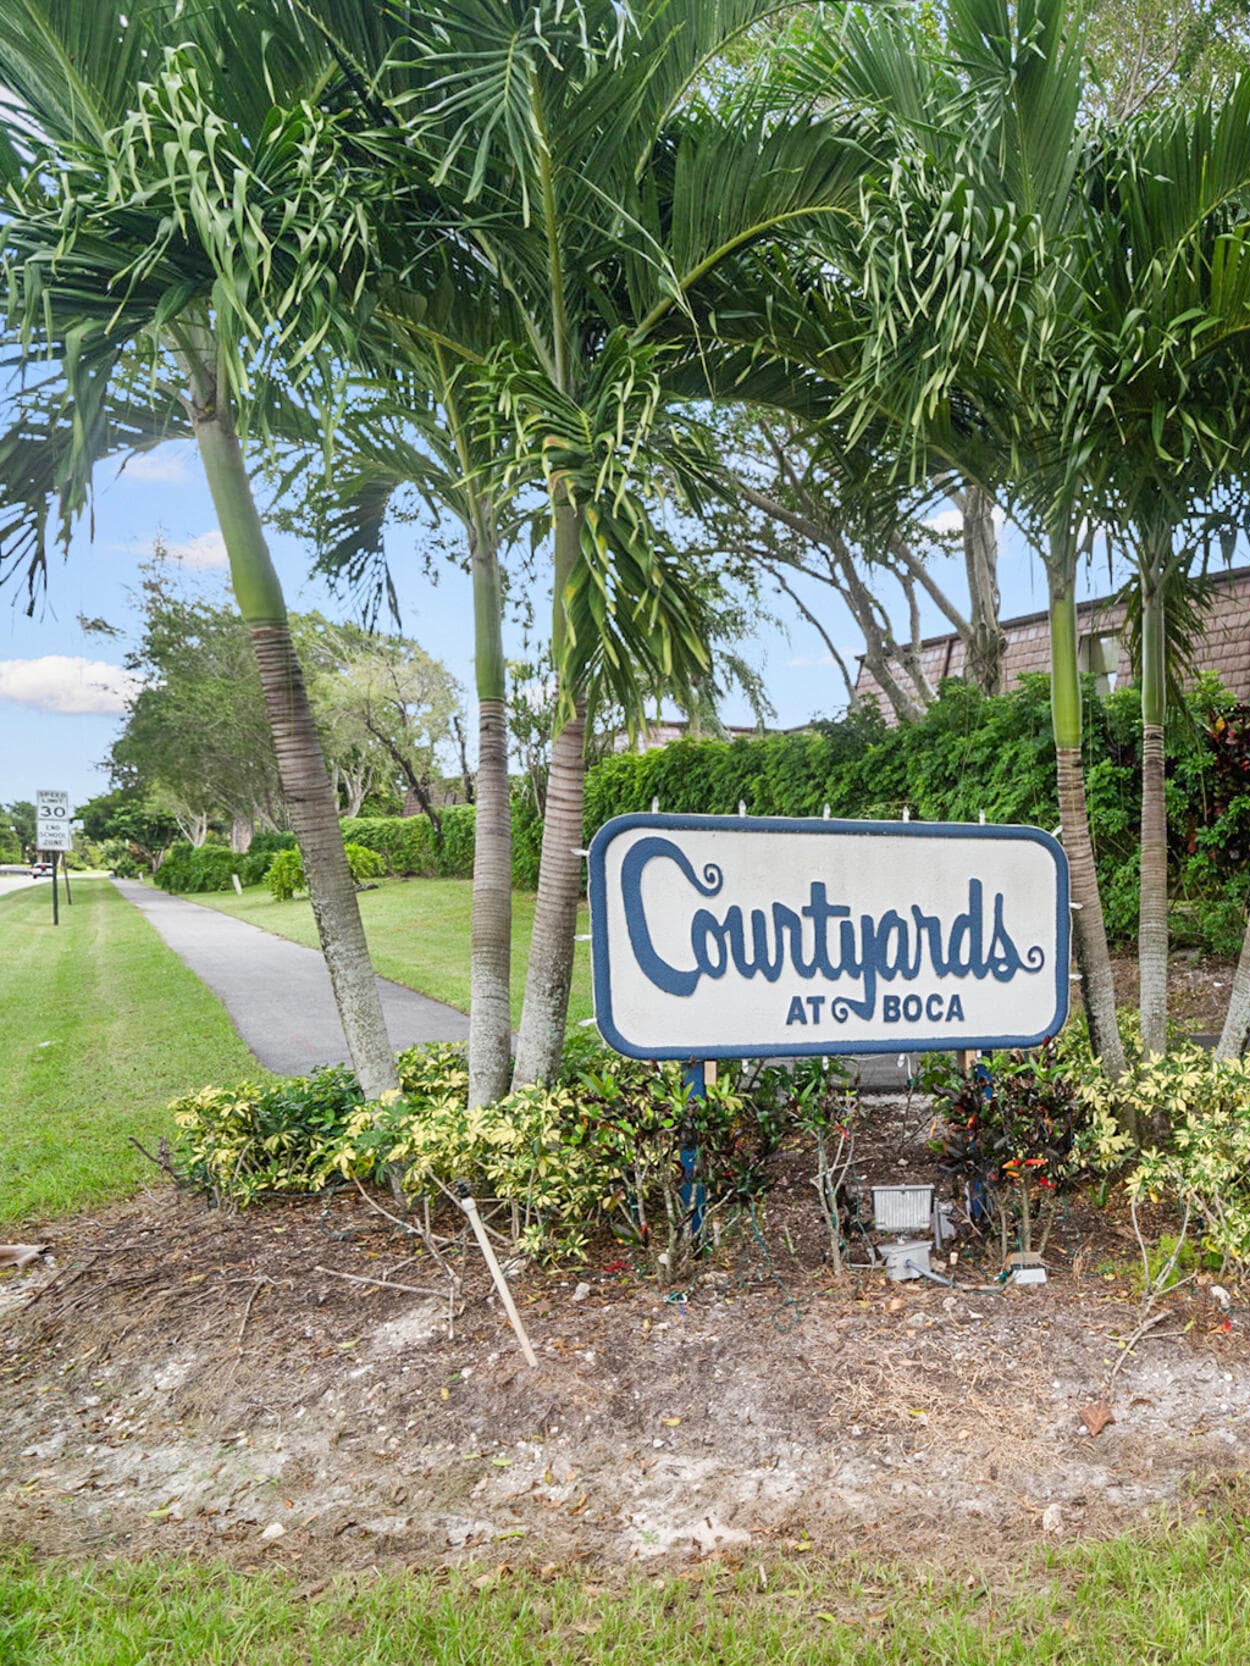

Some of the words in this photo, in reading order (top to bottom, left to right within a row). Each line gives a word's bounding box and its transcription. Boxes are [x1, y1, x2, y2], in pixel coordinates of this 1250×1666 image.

[40, 806, 66, 818] 30
[620, 836, 1045, 1023] Courtyards
[785, 996, 826, 1025] AT
[882, 994, 966, 1023] BOCA
